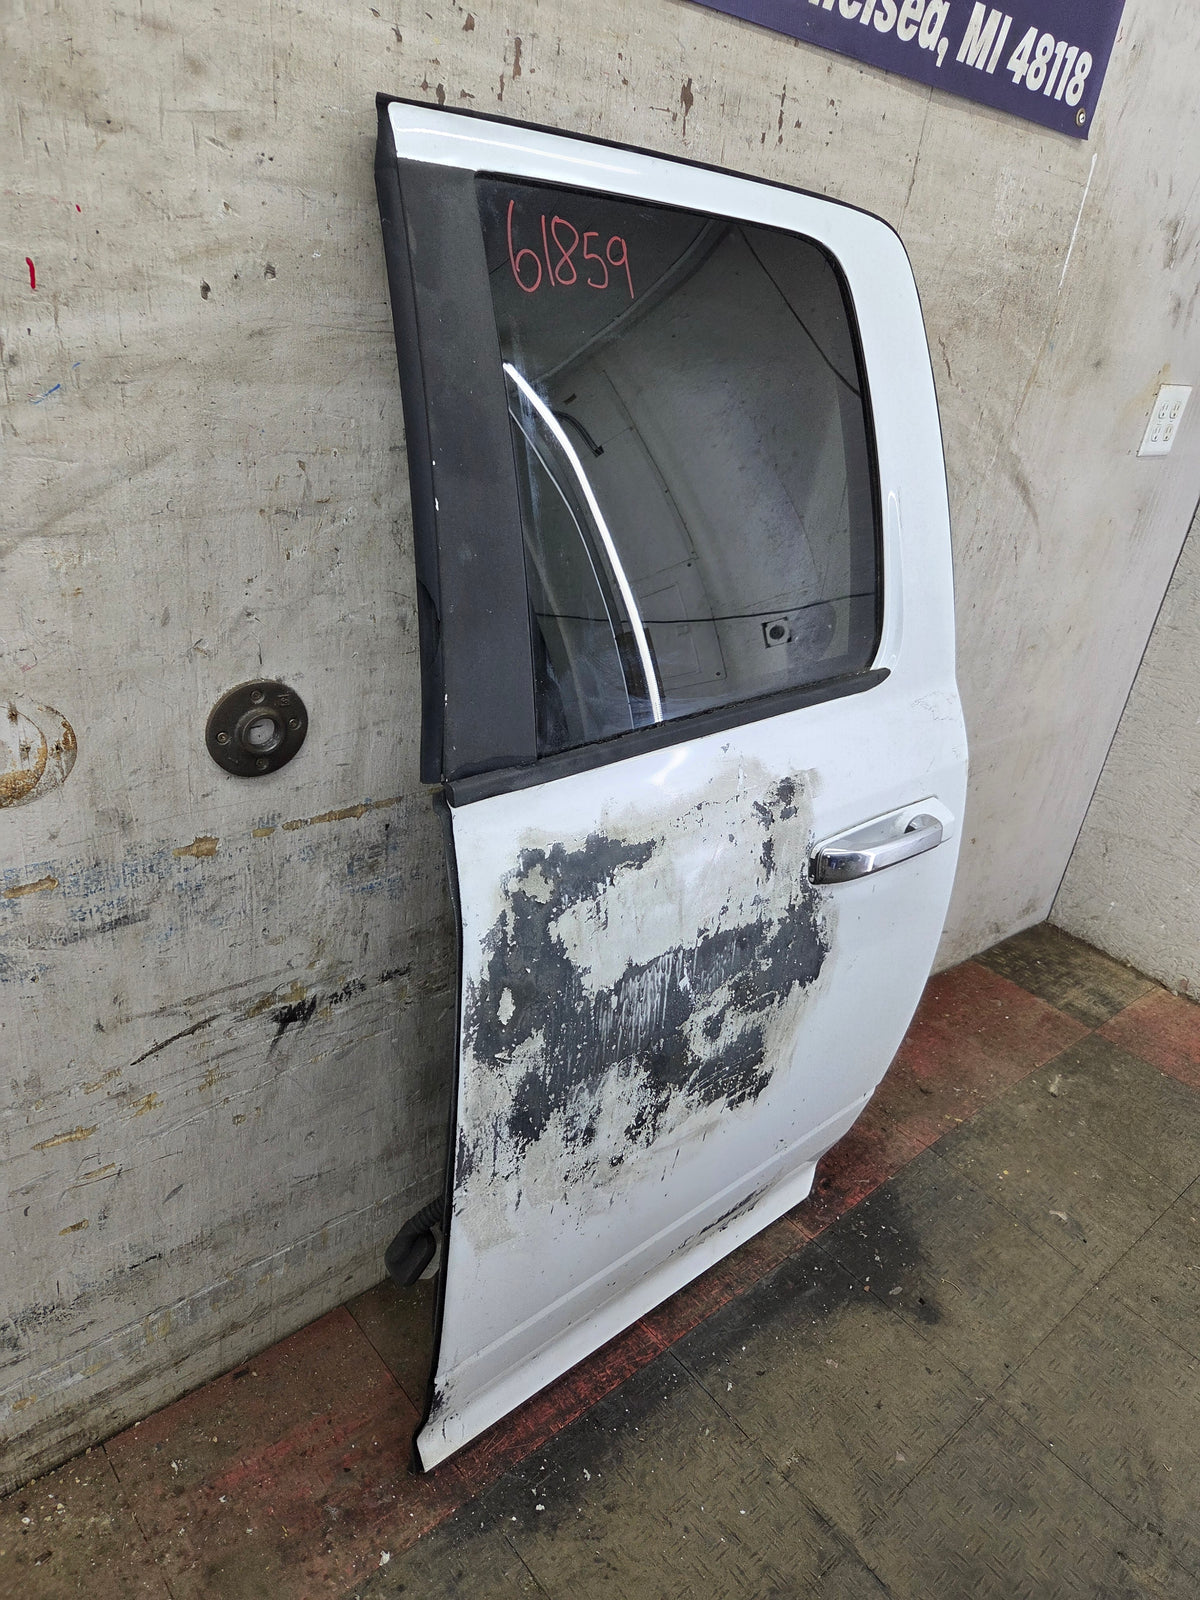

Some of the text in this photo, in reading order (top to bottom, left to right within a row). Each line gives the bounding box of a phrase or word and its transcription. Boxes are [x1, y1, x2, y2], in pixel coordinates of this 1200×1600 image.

[956, 1, 1013, 74] MI
[1006, 26, 1093, 107] 48118
[507, 200, 635, 299] 61859
